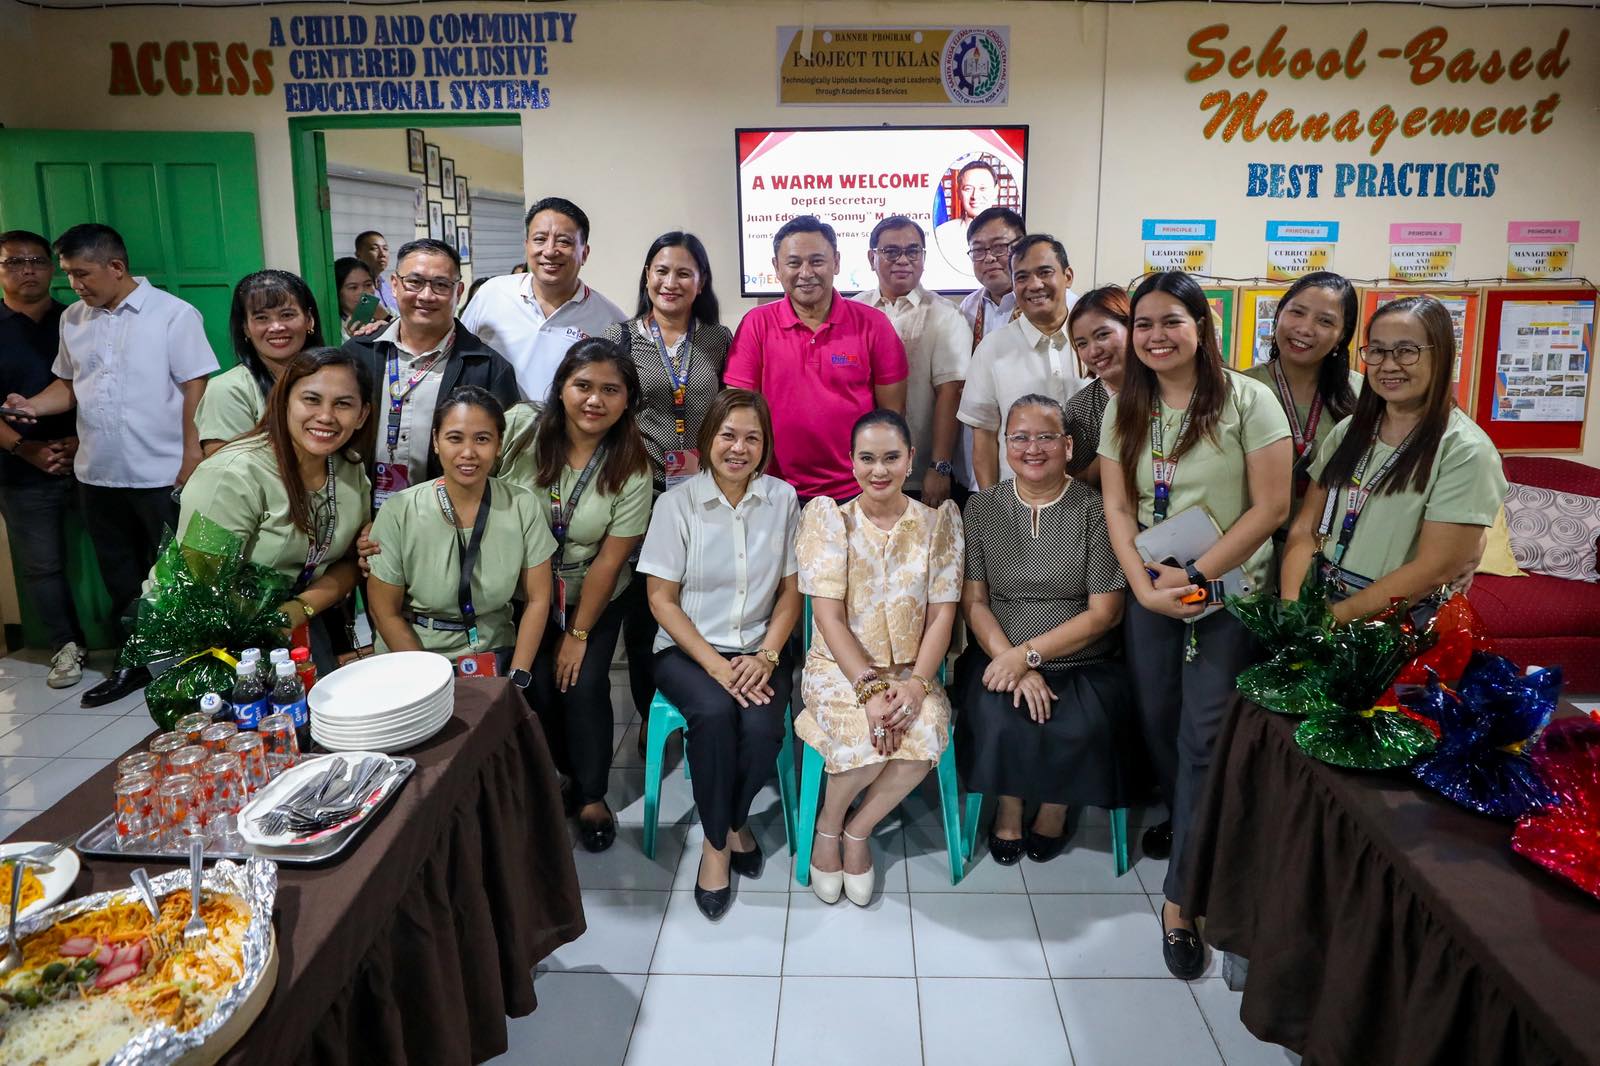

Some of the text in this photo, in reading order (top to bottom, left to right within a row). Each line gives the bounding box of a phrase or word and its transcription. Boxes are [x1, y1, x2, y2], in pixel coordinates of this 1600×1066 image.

[269, 12, 577, 47] A CHILD AND COMMUNITY
[835, 32, 911, 42] BANNER PROGRAM
[289, 45, 548, 80] CENTERED INCLUSIVE
[793, 50, 940, 67] PROJECT TUKLAS
[782, 76, 941, 86] Technologically Upholds Knowledge and Leadership
[283, 80, 445, 112] EDUCATIONAL
[816, 88, 841, 96] through
[1200, 88, 1561, 156] Management
[752, 173, 930, 190] A WARM WELCOME
[1246, 162, 1499, 199] BEST PRACTICES
[791, 196, 886, 208] DepEd Secretary
[747, 213, 772, 222] Juan
